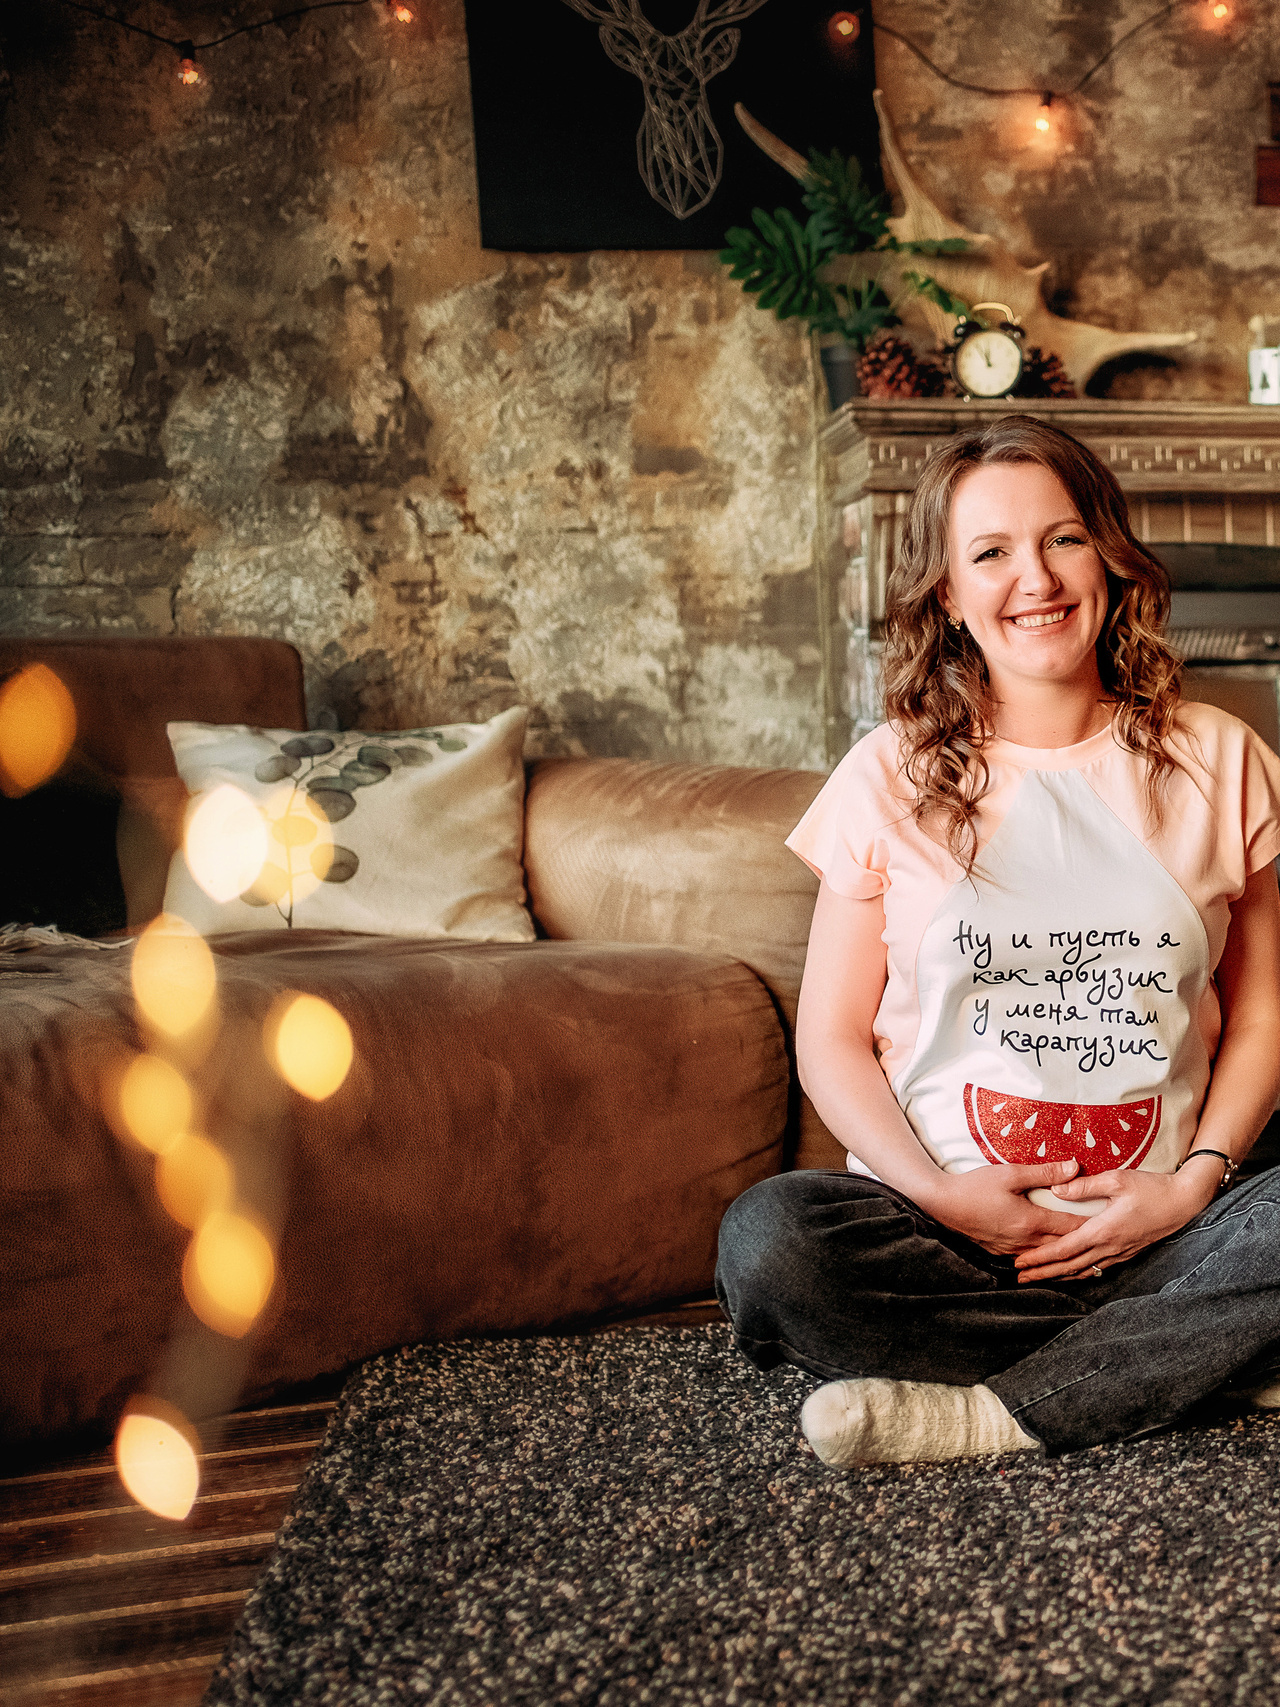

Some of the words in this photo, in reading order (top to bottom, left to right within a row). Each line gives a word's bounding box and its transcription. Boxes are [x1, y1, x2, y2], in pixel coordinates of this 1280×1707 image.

[952, 920, 992, 969] Ну
[1011, 933, 1033, 949] и
[1049, 929, 1141, 965] пусть
[1157, 932, 1181, 948] я
[972, 968, 1039, 986] как
[1044, 953, 1174, 1005] арбузик
[973, 998, 989, 1035] у
[1006, 1003, 1088, 1025] меня
[1100, 1008, 1159, 1027] там
